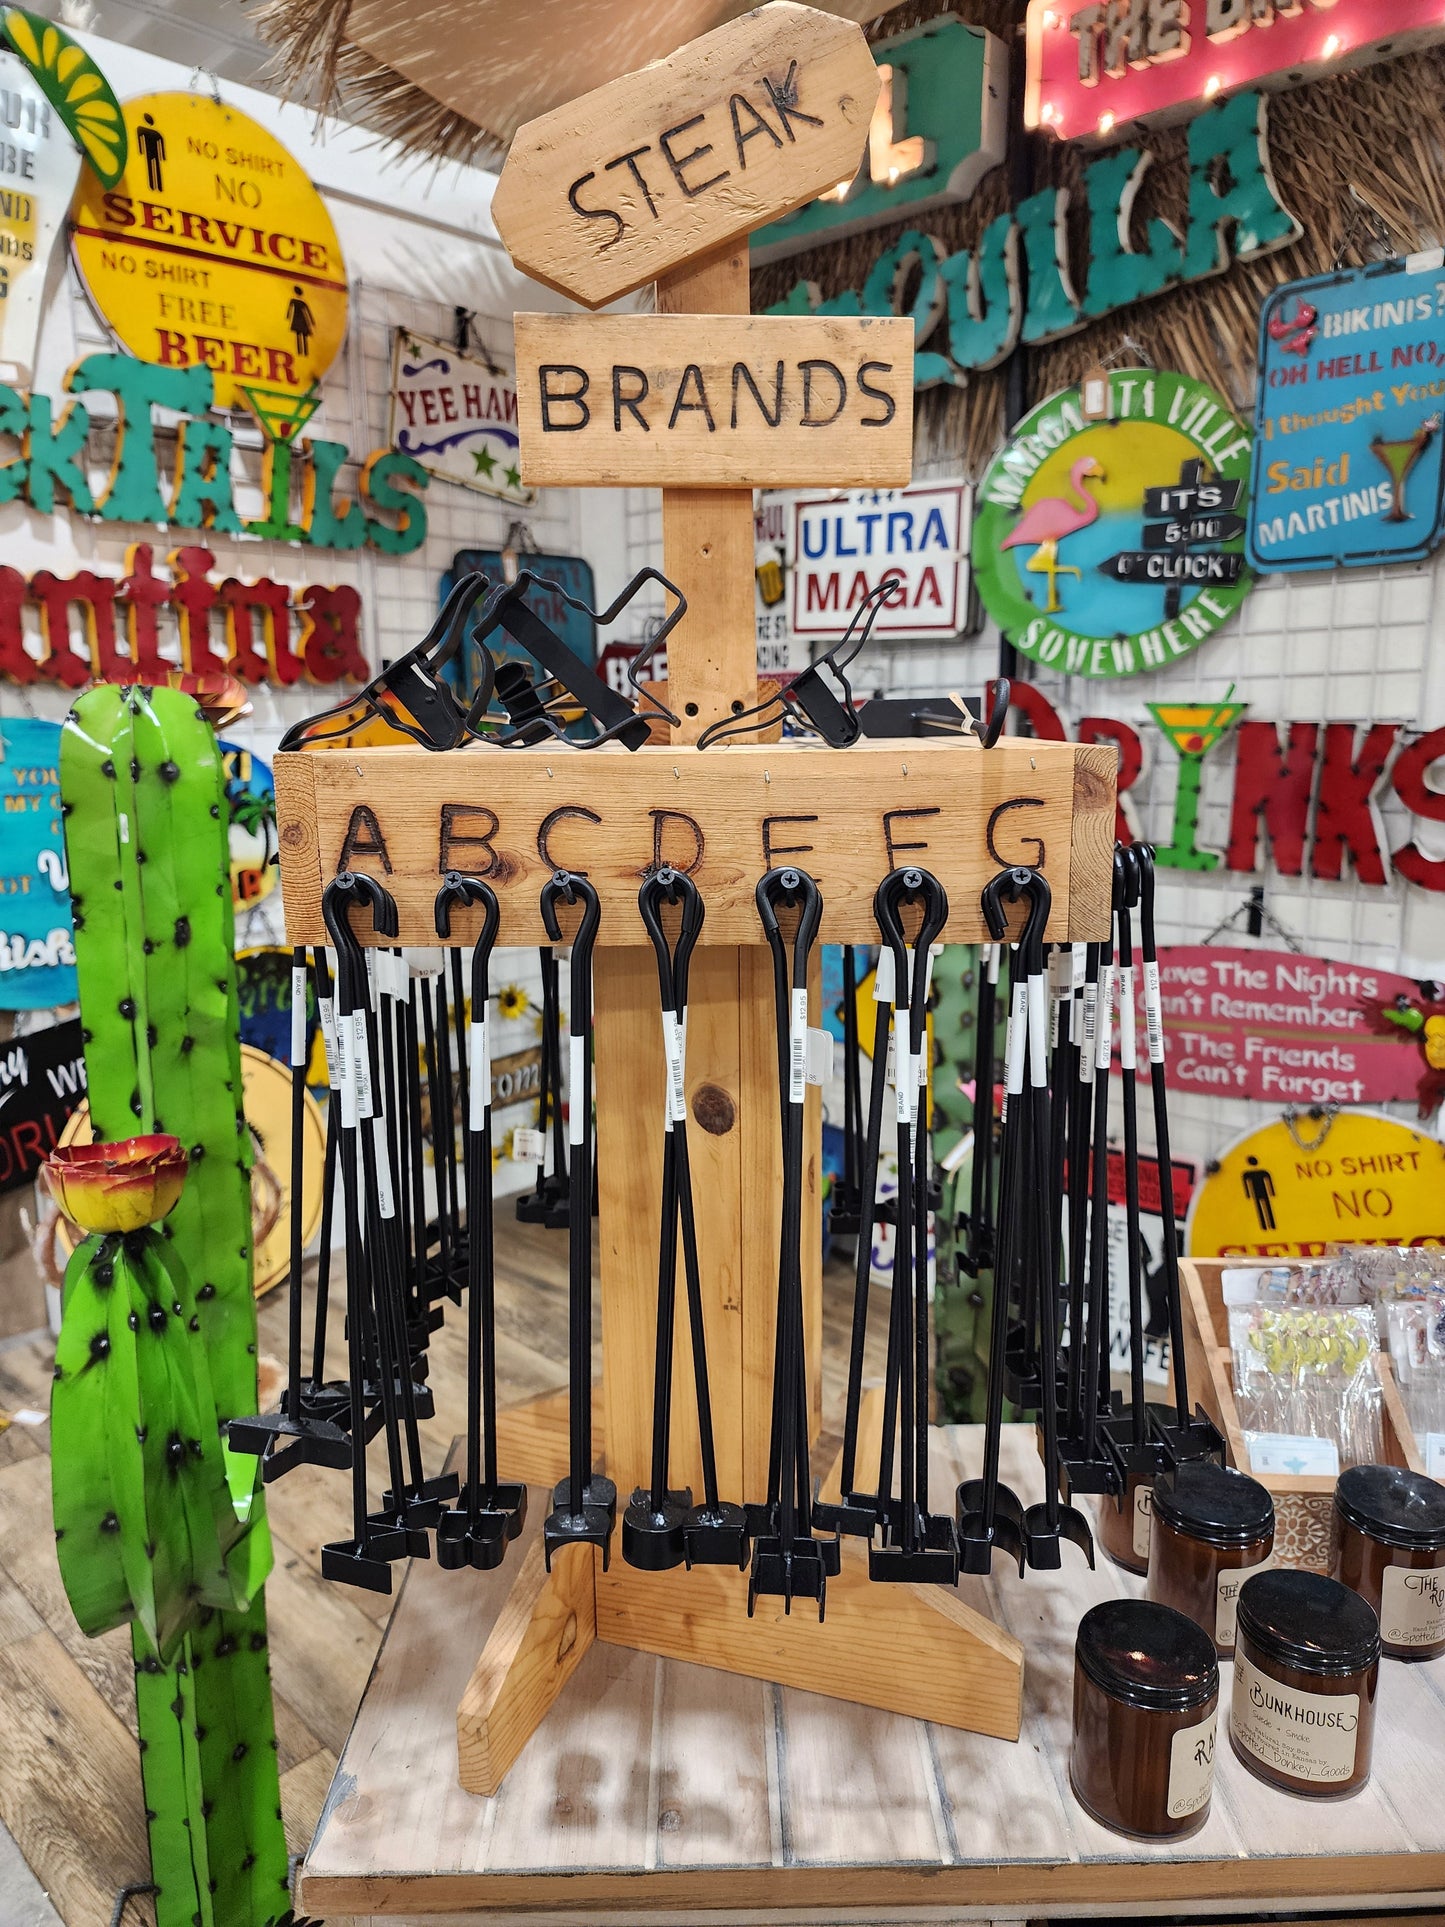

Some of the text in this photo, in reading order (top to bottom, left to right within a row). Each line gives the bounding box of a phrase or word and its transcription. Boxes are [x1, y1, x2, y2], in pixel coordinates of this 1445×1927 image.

[186, 135, 286, 178] NO SHIRT
[568, 59, 824, 251] STEAK
[213, 174, 263, 209] NO
[101, 192, 330, 272] SERVICE
[101, 249, 212, 289] NO SHIRT
[157, 293, 239, 331] FREE
[154, 327, 300, 386] BEER
[1269, 363, 1308, 389] OH
[1317, 350, 1384, 381] HELL
[398, 387, 460, 428] YEE
[537, 358, 898, 433] BRANDS
[1264, 417, 1275, 442] I
[1278, 390, 1387, 436] thought
[1265, 453, 1352, 495] Said
[802, 508, 950, 560] ULTRA
[1257, 482, 1396, 549] MARTINIS
[806, 566, 944, 613] MAGA
[336, 804, 394, 876] A
[437, 803, 500, 877] B
[537, 805, 602, 878] C
[646, 809, 705, 878] D
[986, 797, 1046, 871] G
[1211, 960, 1269, 989] The
[1276, 965, 1379, 1002] Nights
[1211, 992, 1365, 1028] Remember
[1177, 1032, 1236, 1060] The
[1244, 1038, 1356, 1073] Friends
[1176, 1058, 1249, 1085] Can't
[1262, 1066, 1366, 1102] Forget
[1295, 1150, 1421, 1179] NO SHIRT
[1331, 1187, 1394, 1219] NO
[1249, 1681, 1358, 1732] BUNKHOUSE
[1285, 1729, 1311, 1744] Smoke
